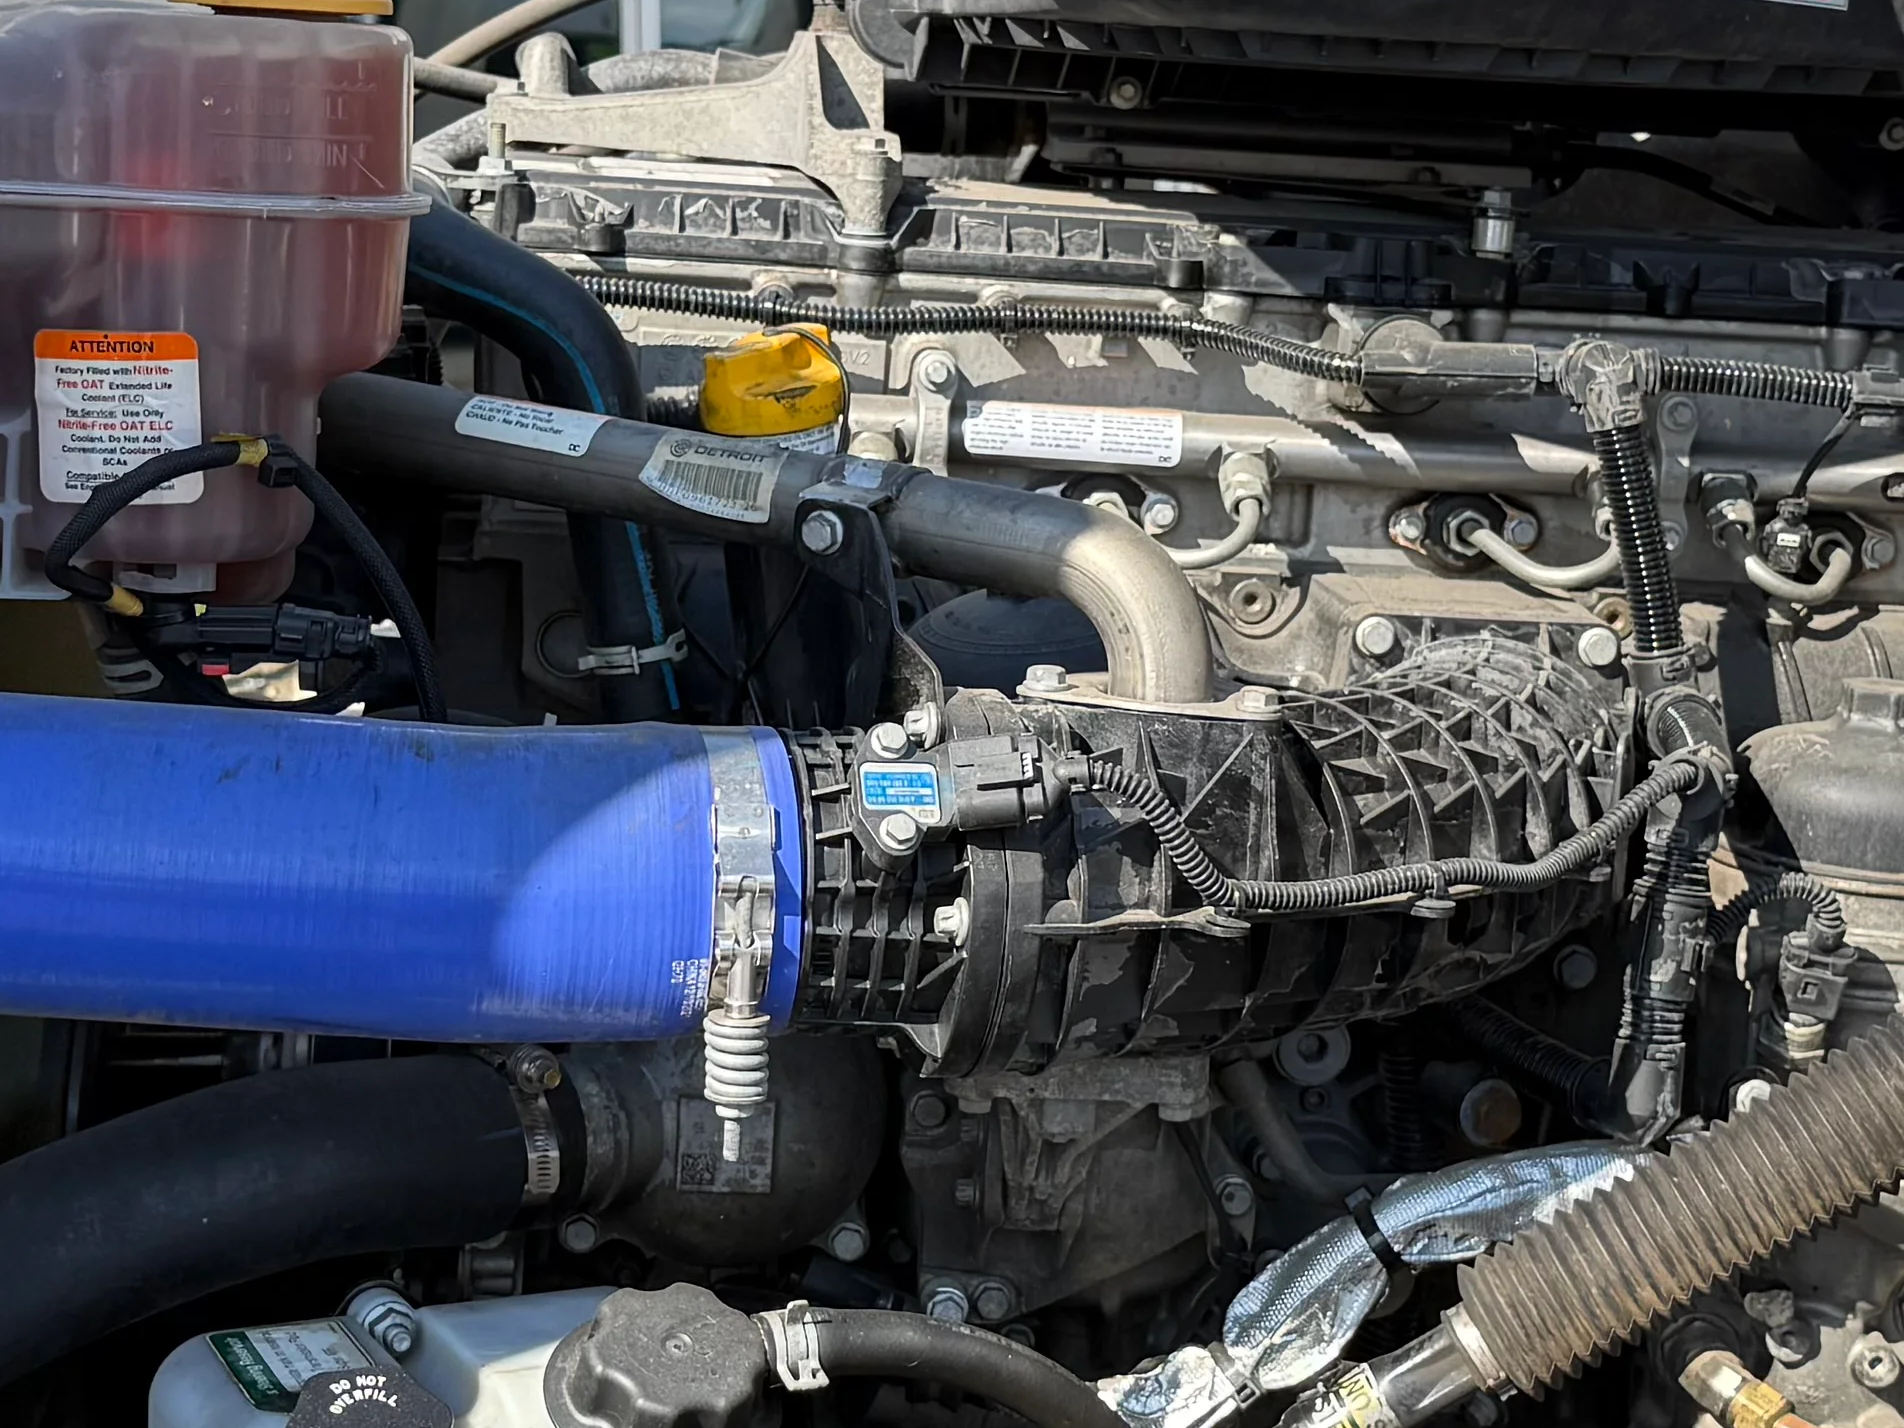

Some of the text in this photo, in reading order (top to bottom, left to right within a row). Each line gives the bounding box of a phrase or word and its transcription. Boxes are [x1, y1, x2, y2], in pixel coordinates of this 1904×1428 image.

[70, 340, 154, 353] ATTENTION
[56, 365, 173, 376] Factory Filled with Nitrite-
[57, 379, 77, 389] Free
[81, 380, 104, 389] OAT
[109, 382, 152, 390] Extended
[82, 394, 144, 404] Coolant (ELC)
[143, 410, 164, 419] Only
[58, 420, 173, 431] Nitrite-Free OAT ELC
[109, 435, 121, 443] Do
[143, 435, 161, 443] Add
[62, 446, 117, 454] Conventional
[120, 446, 161, 454] Coolants
[694, 446, 768, 463] DETROIT
[102, 458, 127, 466] SCAs
[329, 1375, 386, 1394] DO NOT
[329, 1389, 398, 1415] OVERFILL
